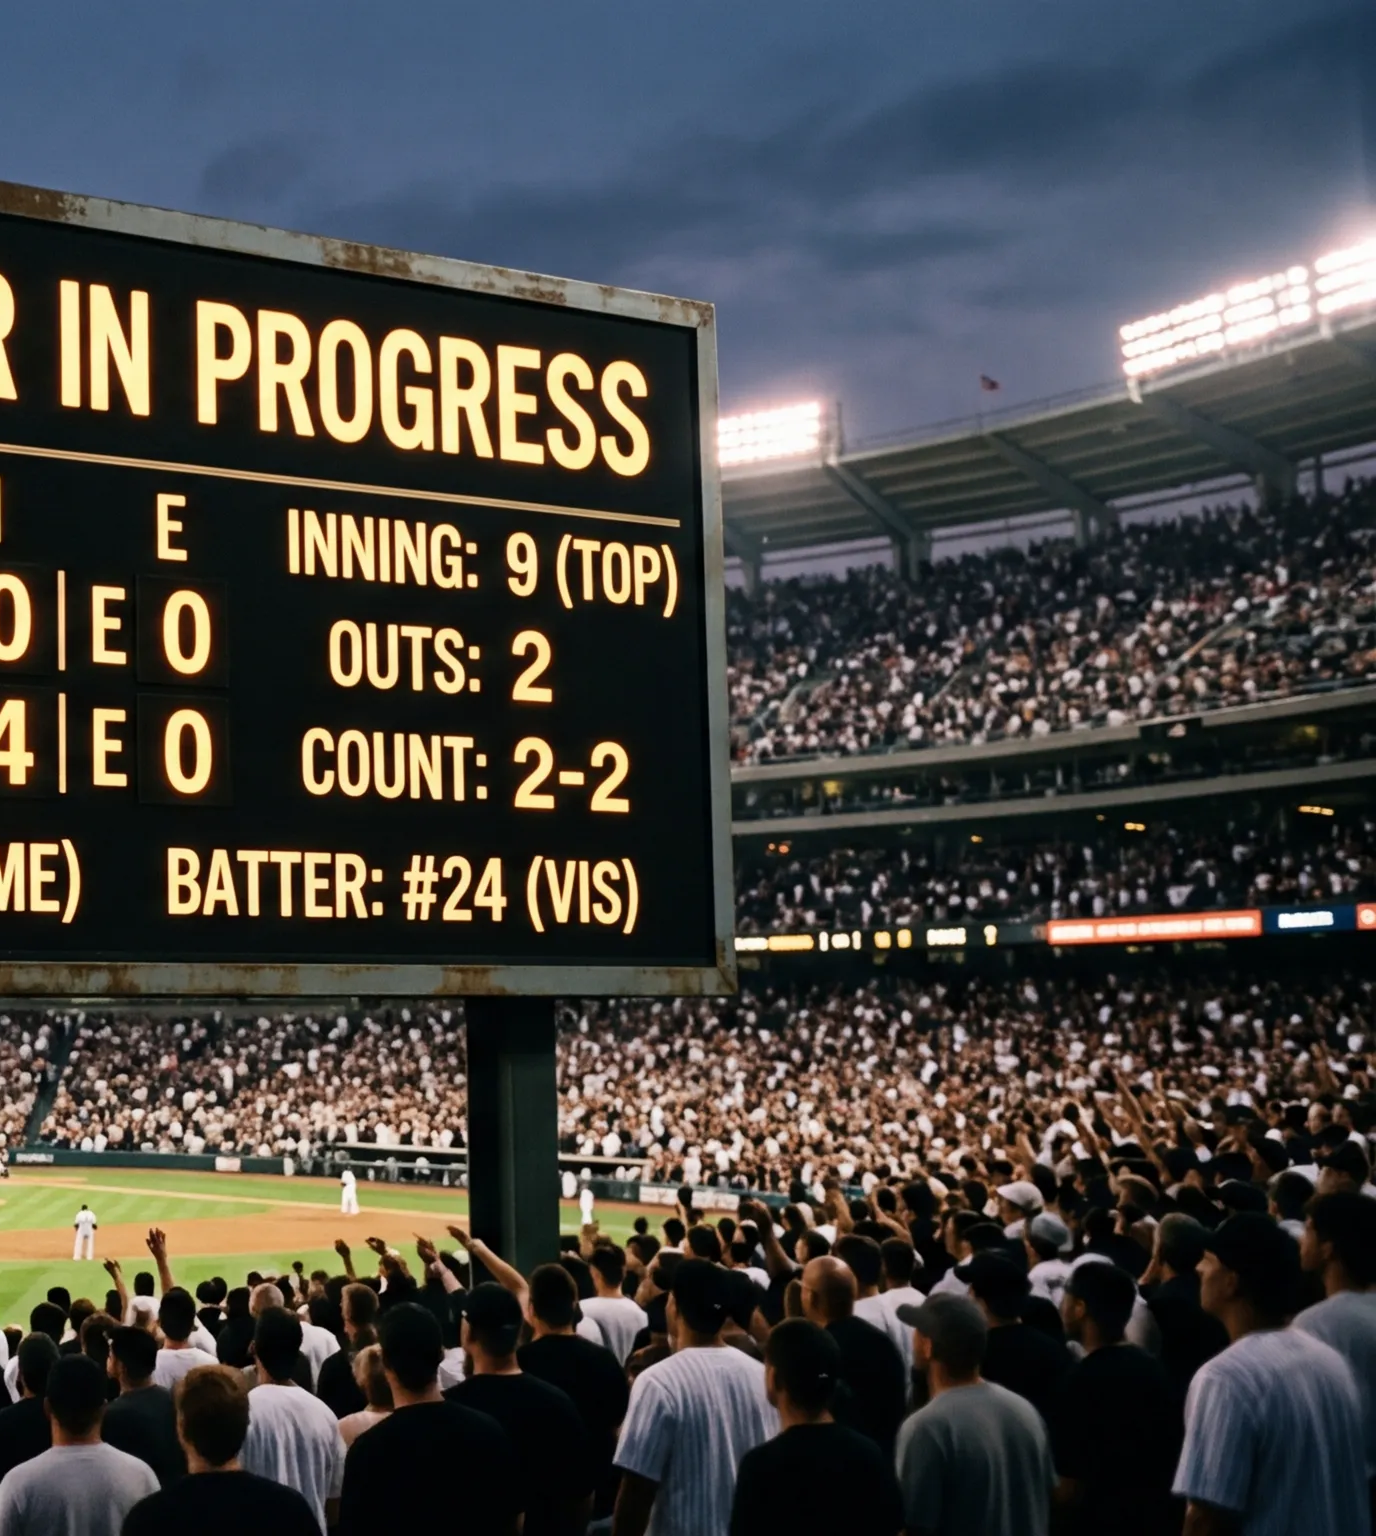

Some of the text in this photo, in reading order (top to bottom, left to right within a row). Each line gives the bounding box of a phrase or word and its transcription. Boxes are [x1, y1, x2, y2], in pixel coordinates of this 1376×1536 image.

[58, 278, 151, 418] IN
[195, 298, 651, 478] PROGRESS
[155, 492, 189, 563] E
[286, 507, 679, 619] INNING: 9 (TOP)
[90, 584, 128, 666] E
[161, 588, 212, 676] 0
[328, 618, 554, 704] OUTS: 2
[91, 706, 129, 788] E
[163, 707, 214, 795] 0
[300, 726, 631, 814] COUNT: 2-2
[166, 846, 640, 936] BATTER: #24 (VIS)
